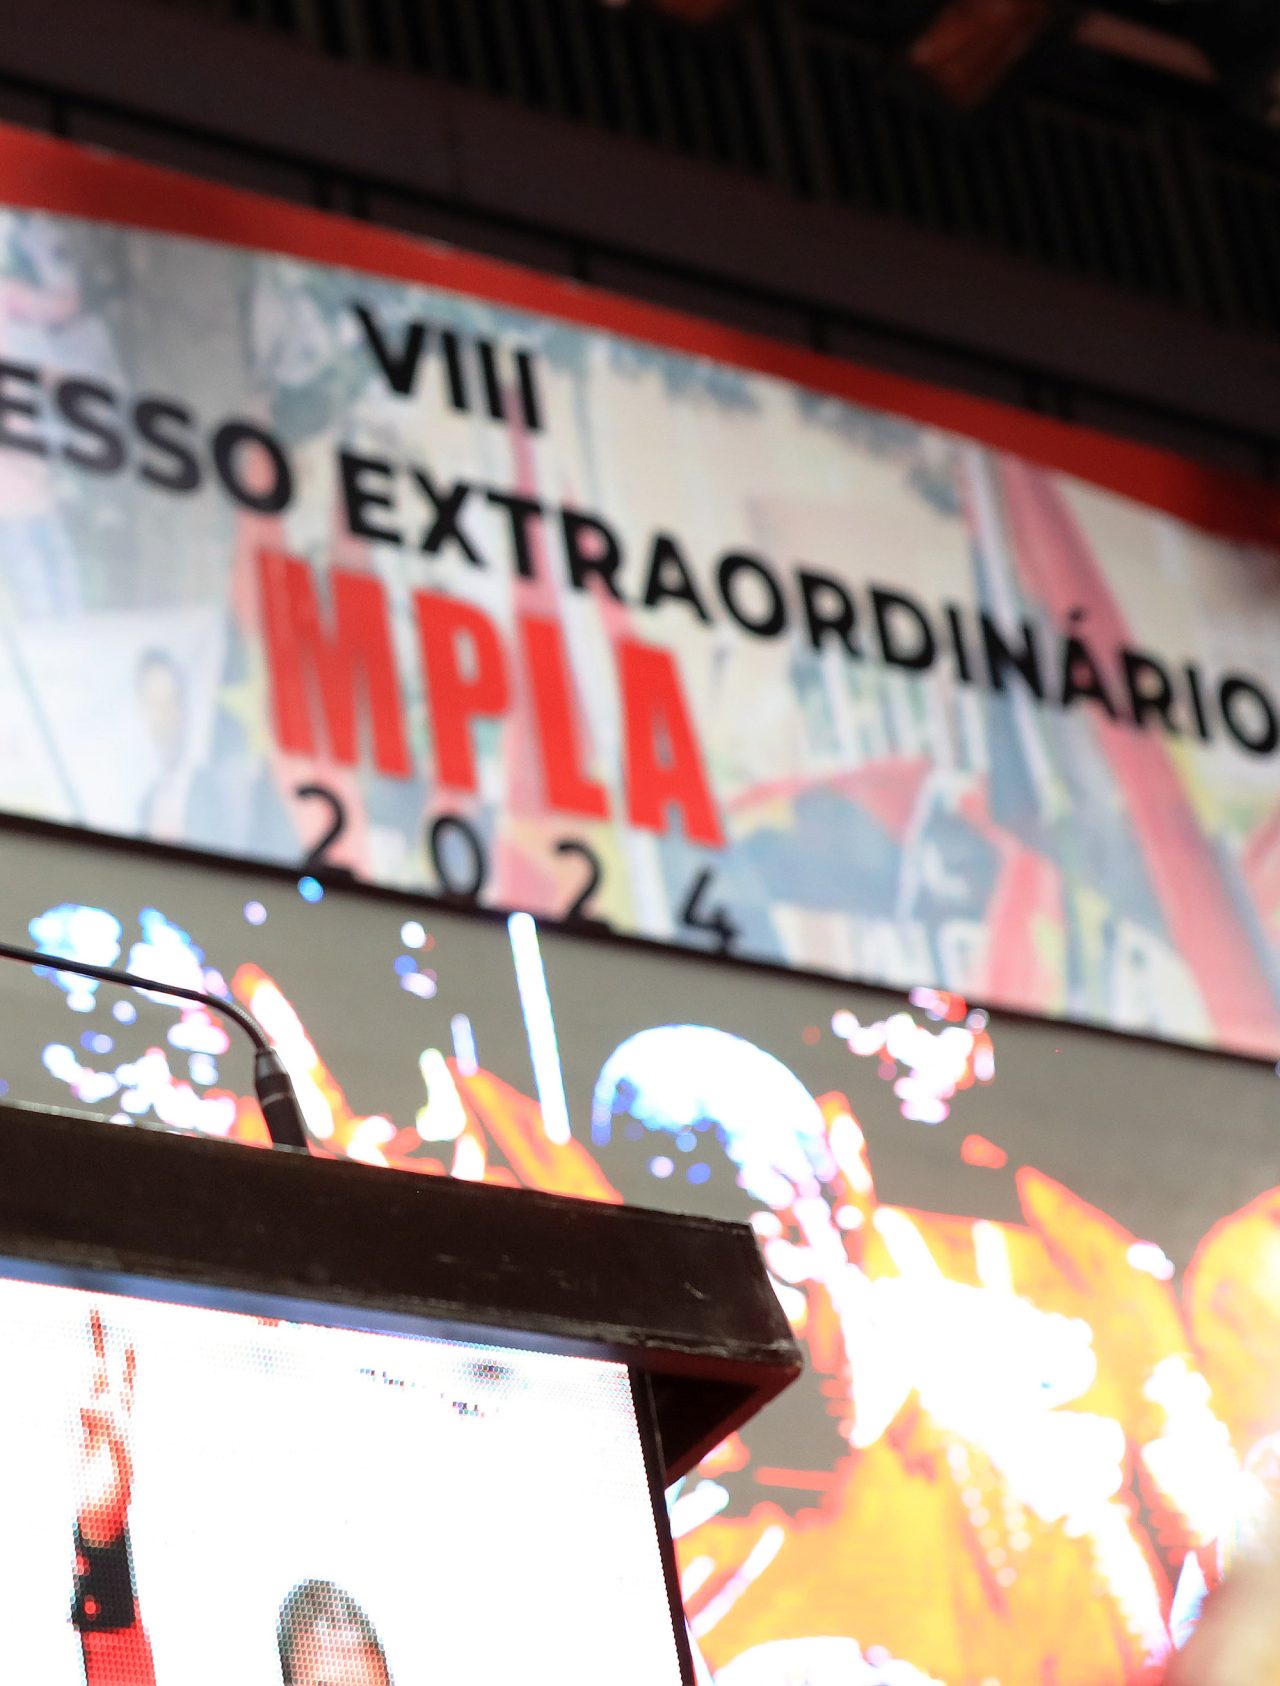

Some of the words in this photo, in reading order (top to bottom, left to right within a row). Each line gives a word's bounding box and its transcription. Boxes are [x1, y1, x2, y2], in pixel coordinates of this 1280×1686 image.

[353, 304, 542, 431] VIII
[256, 548, 726, 848] MPLA
[339, 450, 1280, 756] EXTRAORDINÁRIO
[296, 783, 740, 952] 2024
